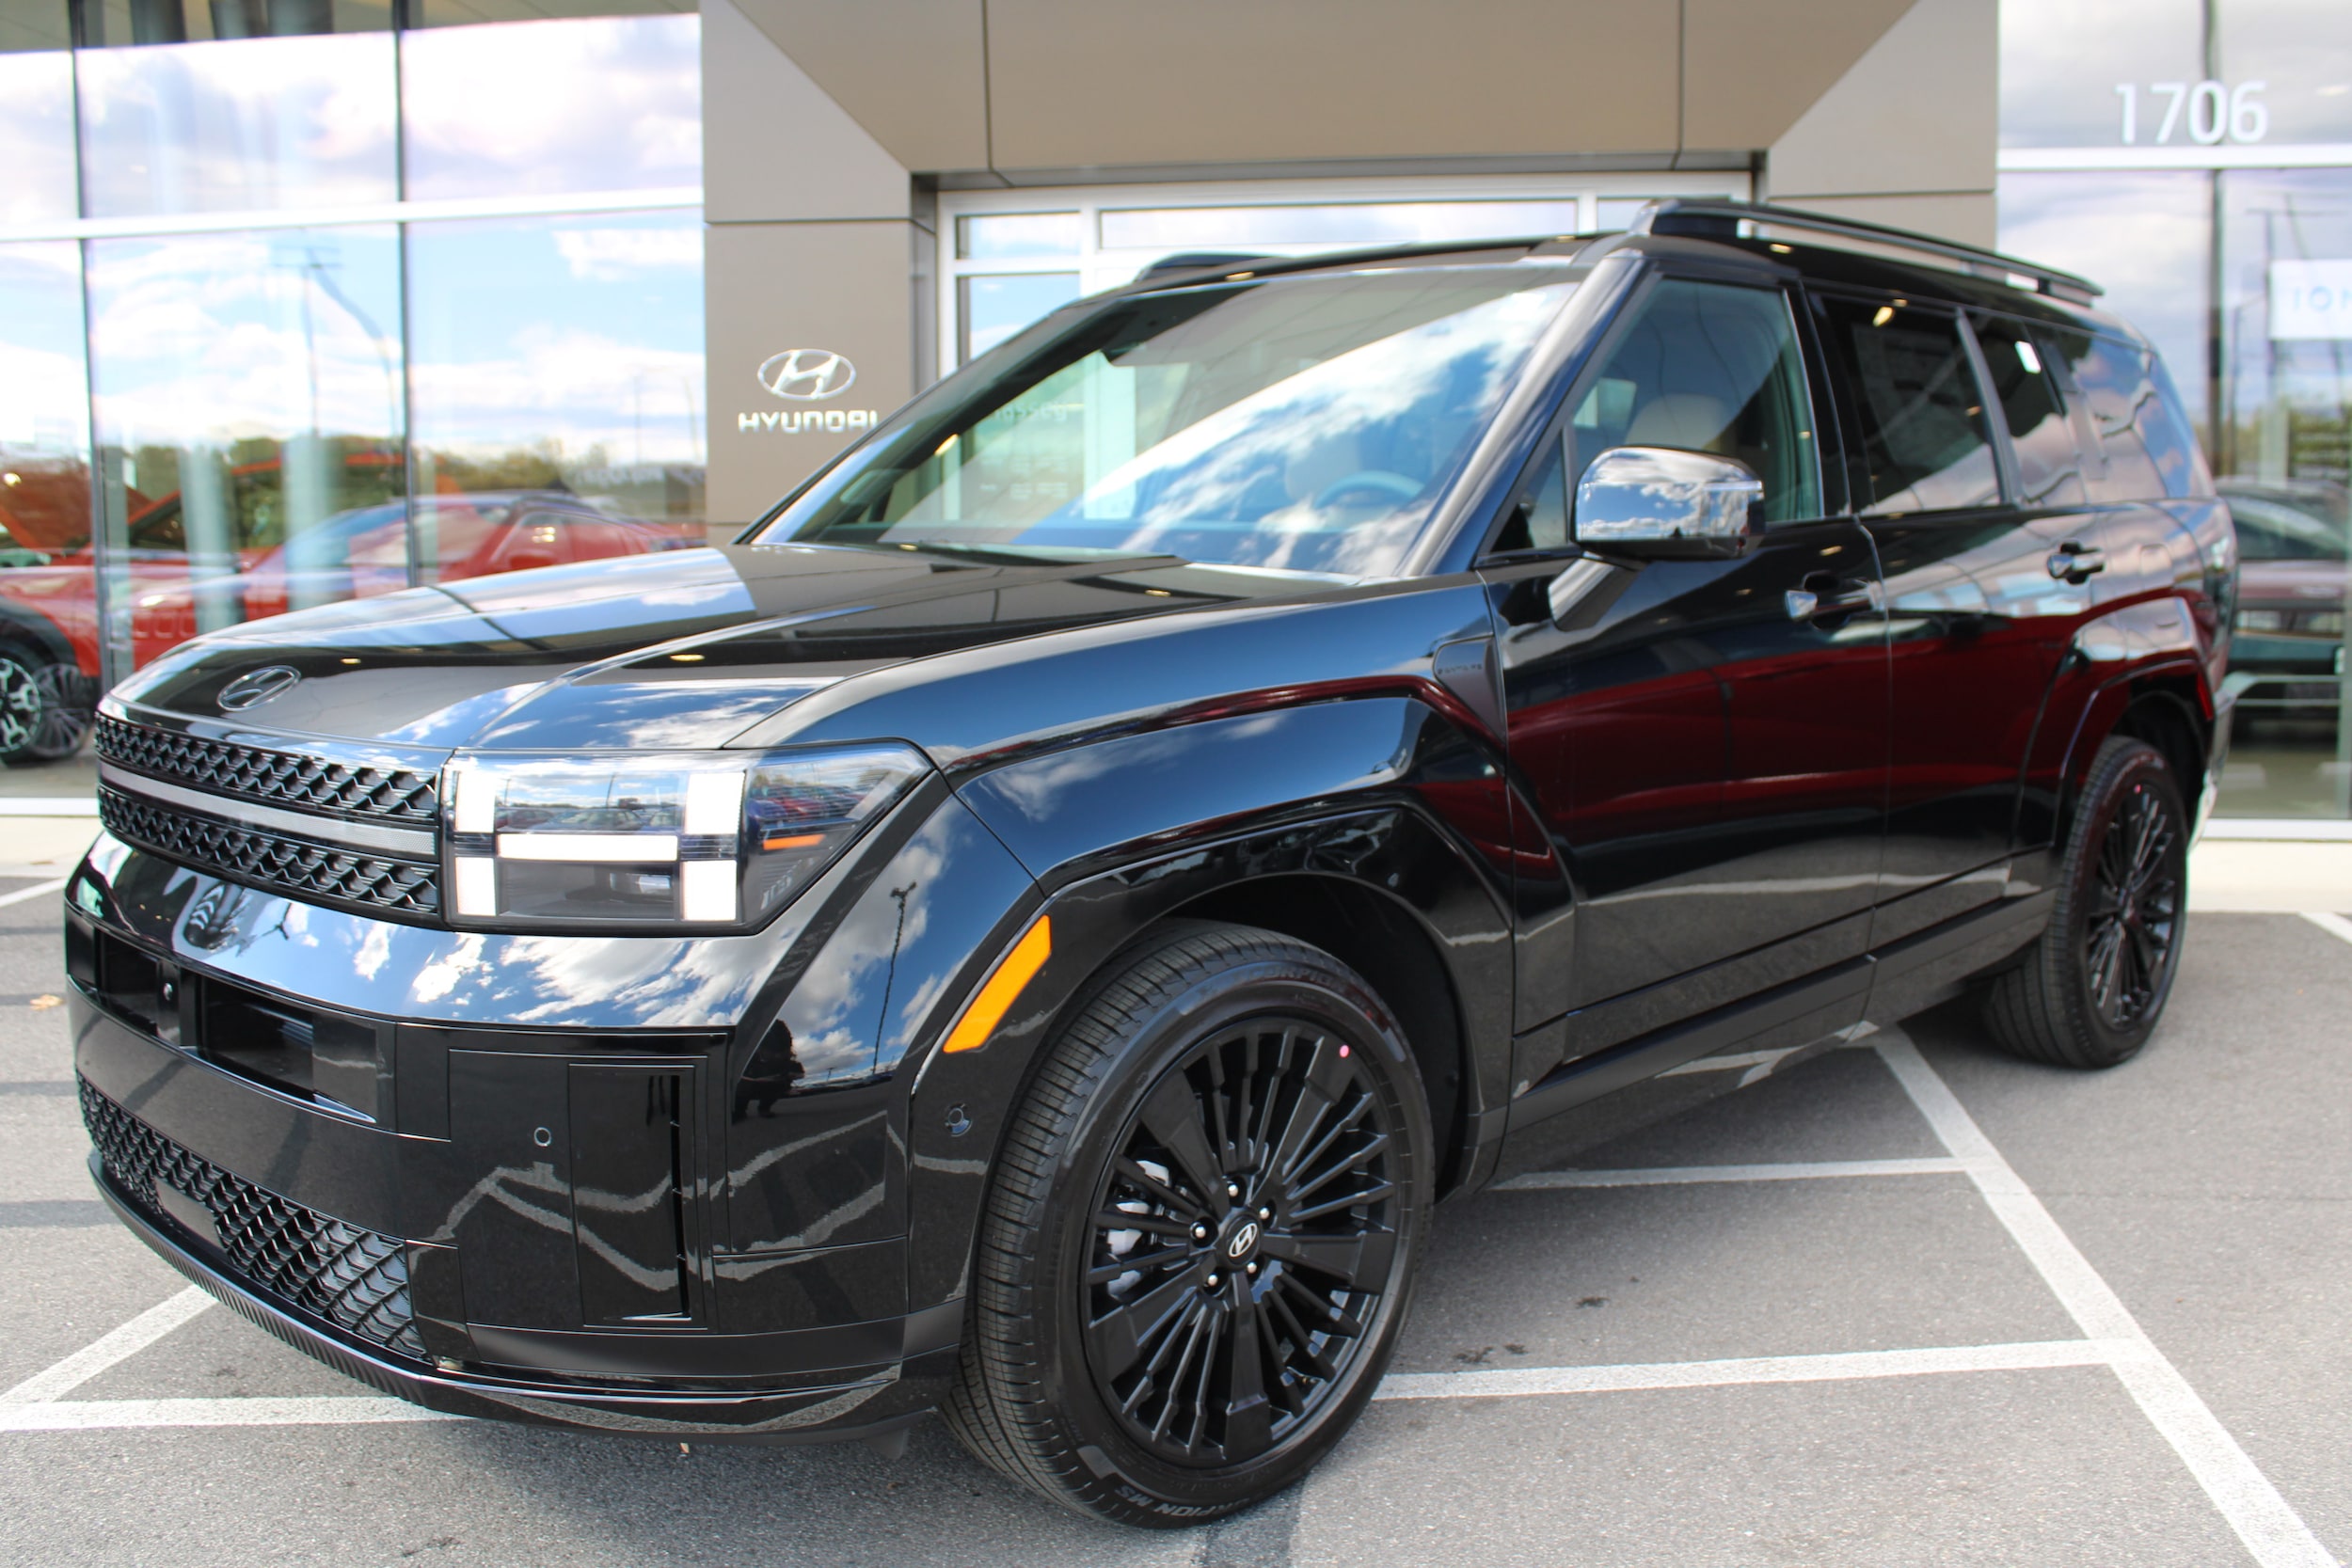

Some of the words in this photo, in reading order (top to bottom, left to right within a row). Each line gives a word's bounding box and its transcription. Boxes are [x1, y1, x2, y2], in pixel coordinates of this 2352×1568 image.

[2114, 79, 2269, 145] 1706
[738, 409, 878, 434] HYUNDAI
[994, 404, 1068, 423] assey
[1114, 1484, 1153, 1507] MS
[1153, 1497, 1251, 1517] RPION
